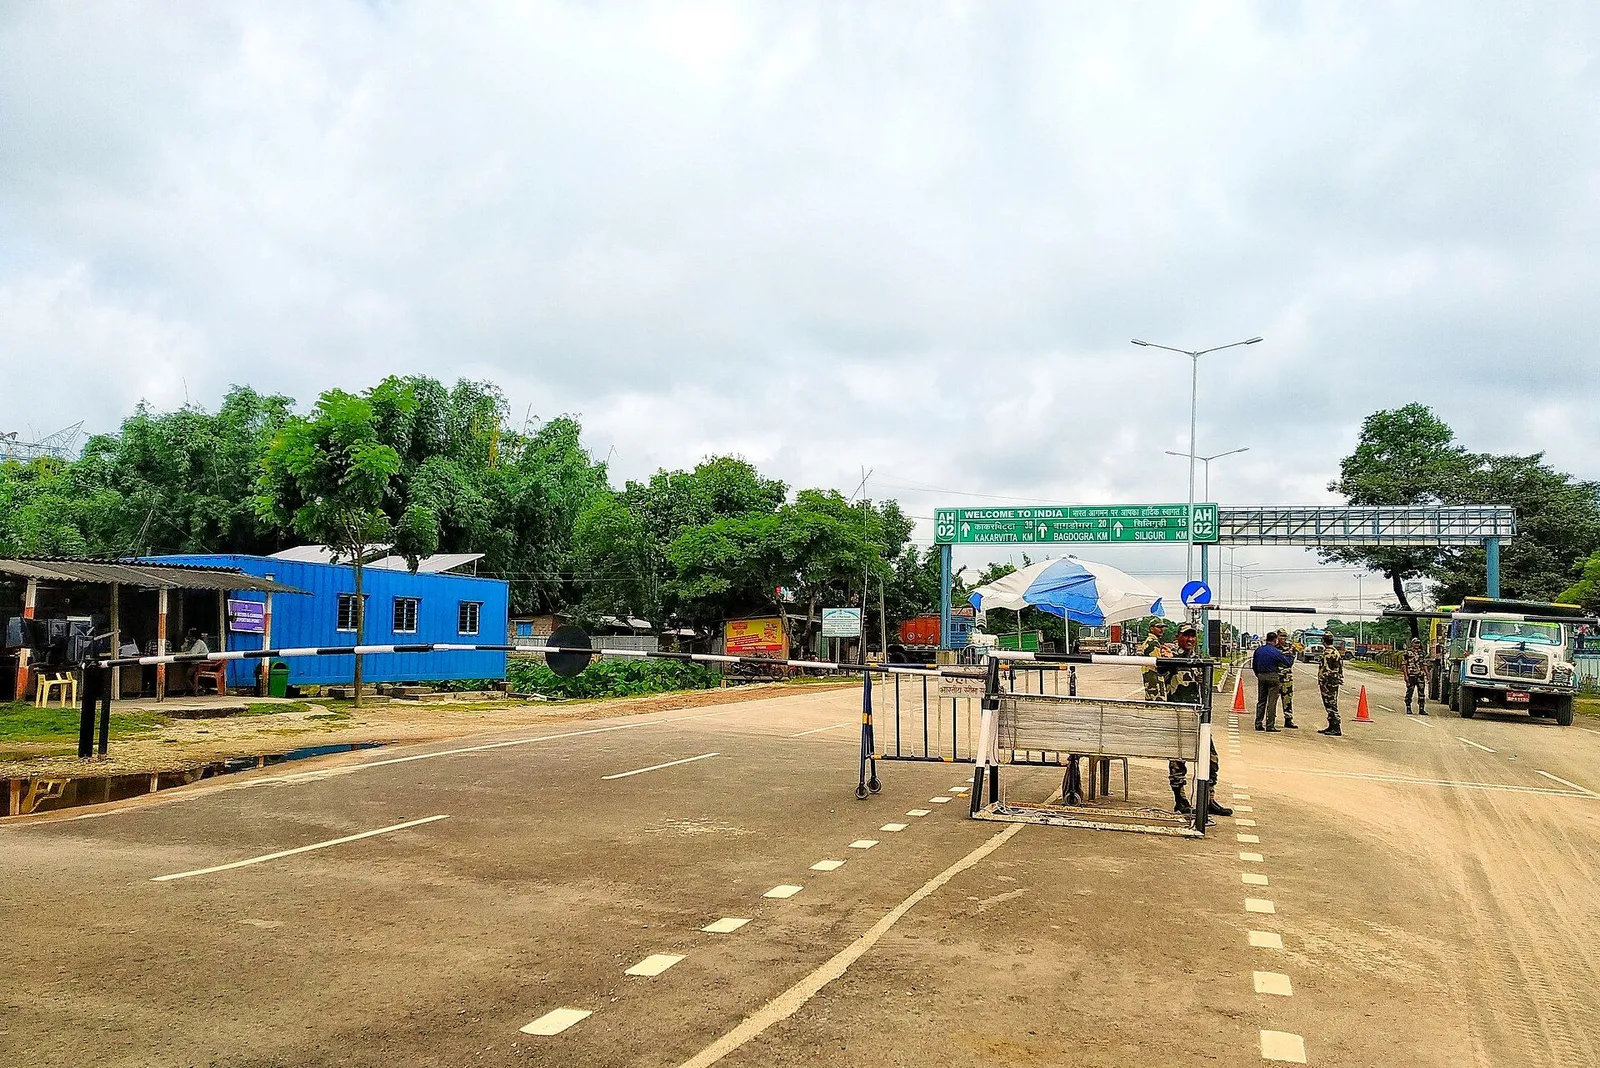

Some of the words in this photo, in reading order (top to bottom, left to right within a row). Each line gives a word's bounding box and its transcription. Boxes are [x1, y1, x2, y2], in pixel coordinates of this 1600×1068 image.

[964, 510, 1015, 519] WELCOME
[1017, 509, 1031, 518] TO
[1034, 509, 1063, 518] INDIA
[1110, 508, 1119, 517] पर
[1120, 508, 1139, 516] आपका
[1194, 508, 1212, 522] AH
[938, 512, 955, 524] AH
[1177, 518, 1187, 527] 15
[1098, 519, 1107, 528] 20
[1194, 522, 1212, 535] 02
[937, 525, 955, 537] 02
[1053, 532, 1094, 541] BAGDOGRA
[1097, 531, 1108, 541] KM
[1134, 531, 1166, 540] SILIGURI
[1176, 530, 1188, 540] KM
[974, 533, 1018, 542] KAKARVITTA
[1022, 532, 1033, 542] KM
